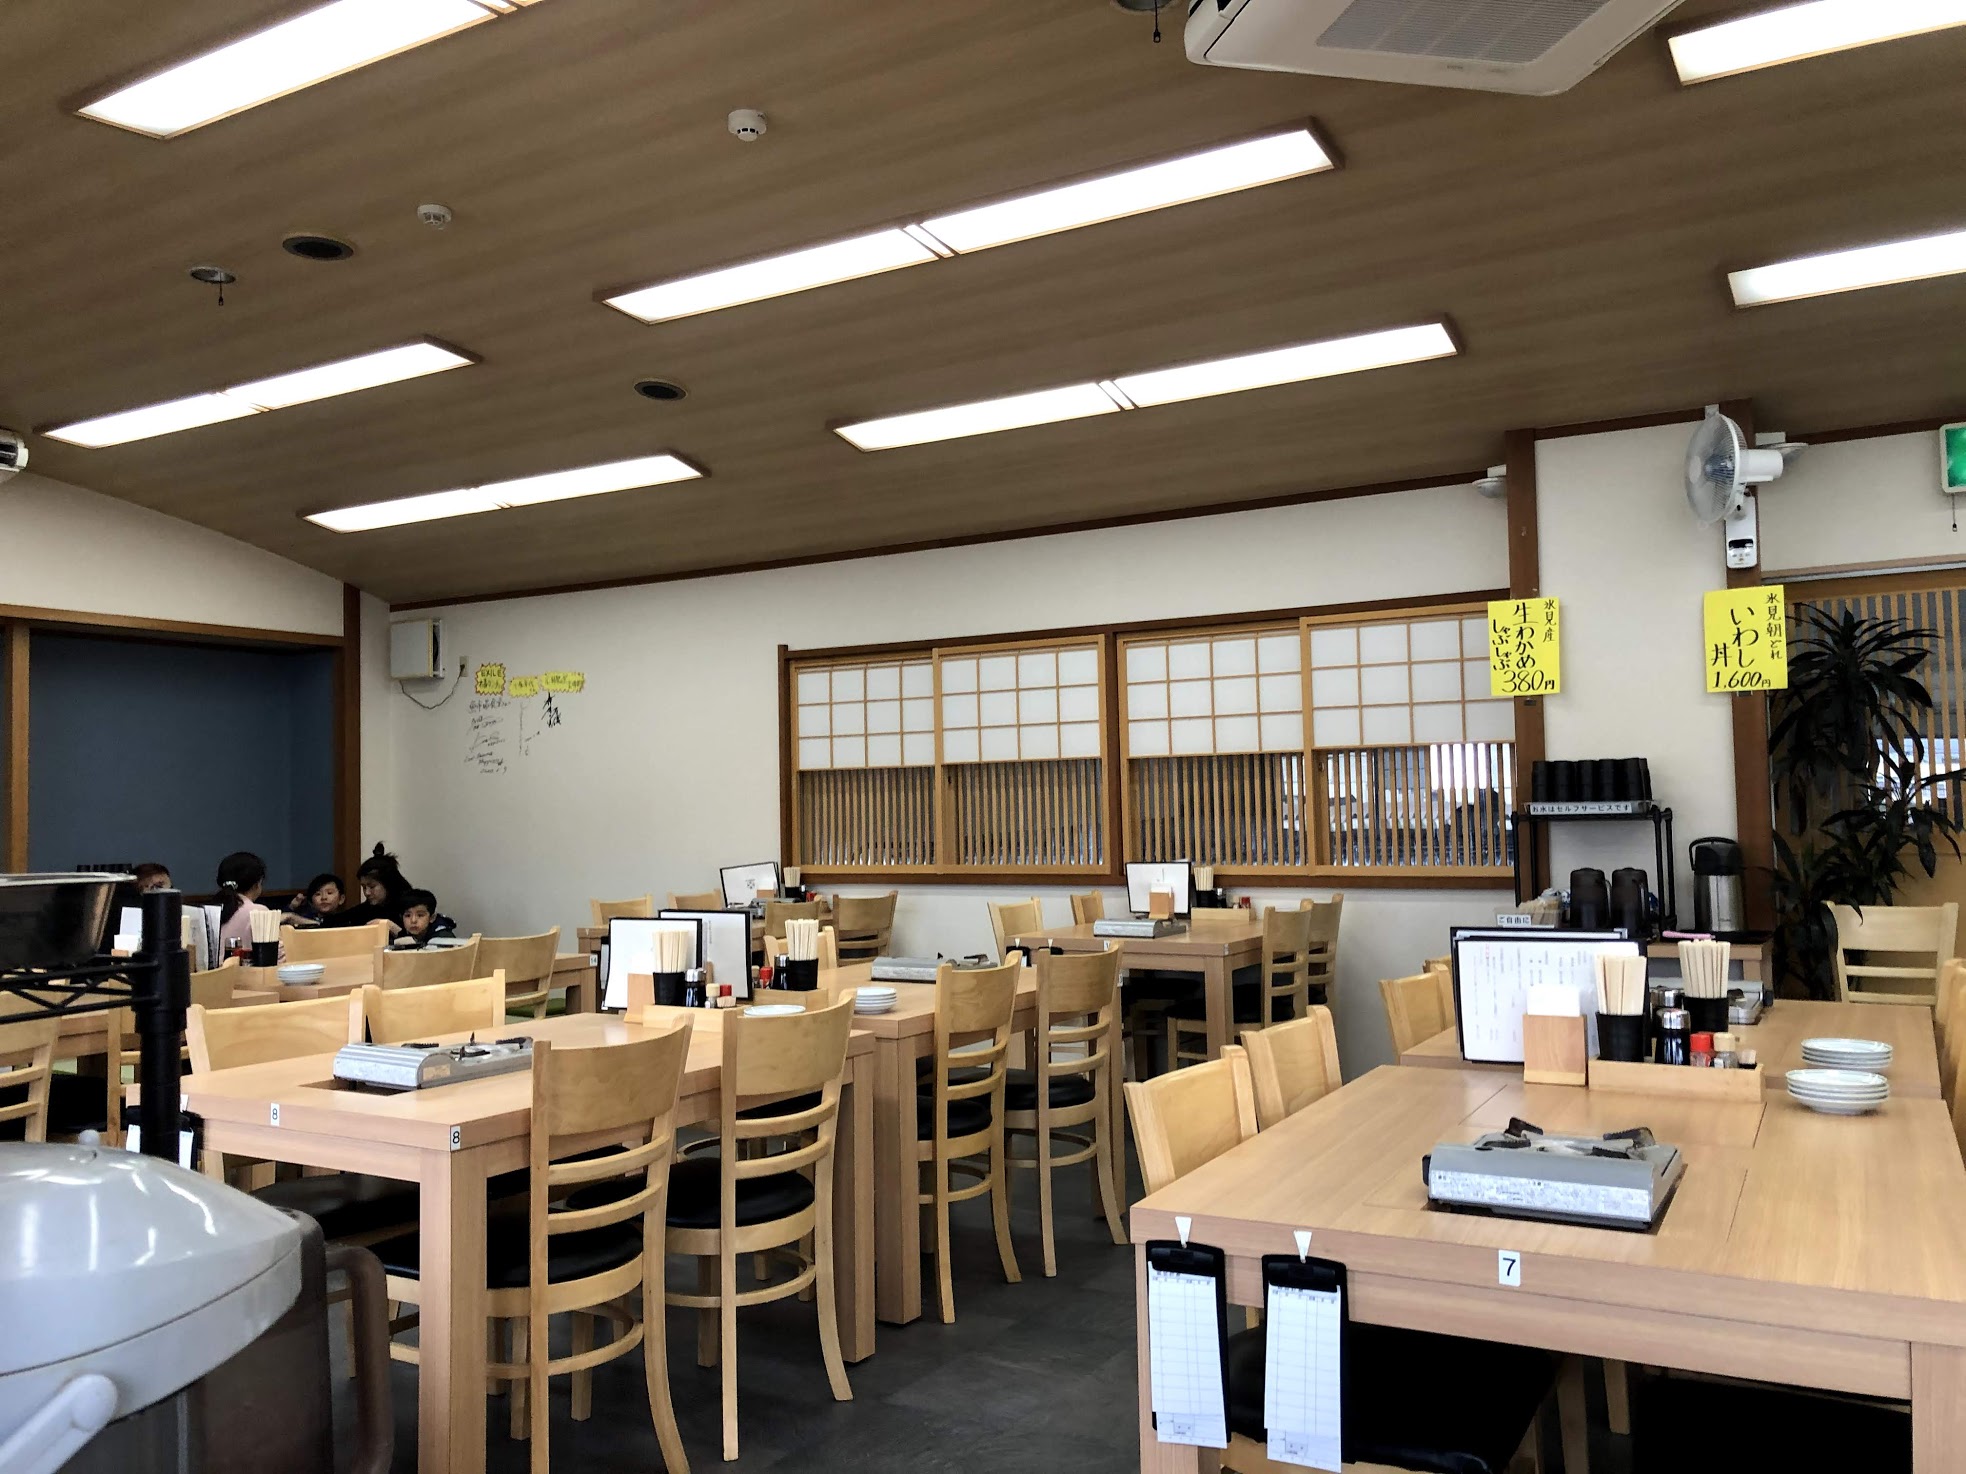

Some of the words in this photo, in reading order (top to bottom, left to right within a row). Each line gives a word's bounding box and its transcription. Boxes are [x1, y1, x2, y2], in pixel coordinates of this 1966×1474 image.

[1543, 599, 1556, 643] 氷見産
[1492, 619, 1511, 671] しゃぶしゃぶ
[1513, 602, 1539, 669] 生わかめ
[1730, 607, 1759, 668] いわし
[1711, 643, 1732, 668] 丼
[481, 669, 502, 678] EXILE
[1502, 669, 1555, 693] 380円
[1532, 804, 1628, 812] お水はセルフサービスです
[272, 1108, 278, 1120] 8
[452, 1131, 460, 1144] 8
[1502, 1257, 1516, 1277] 7
